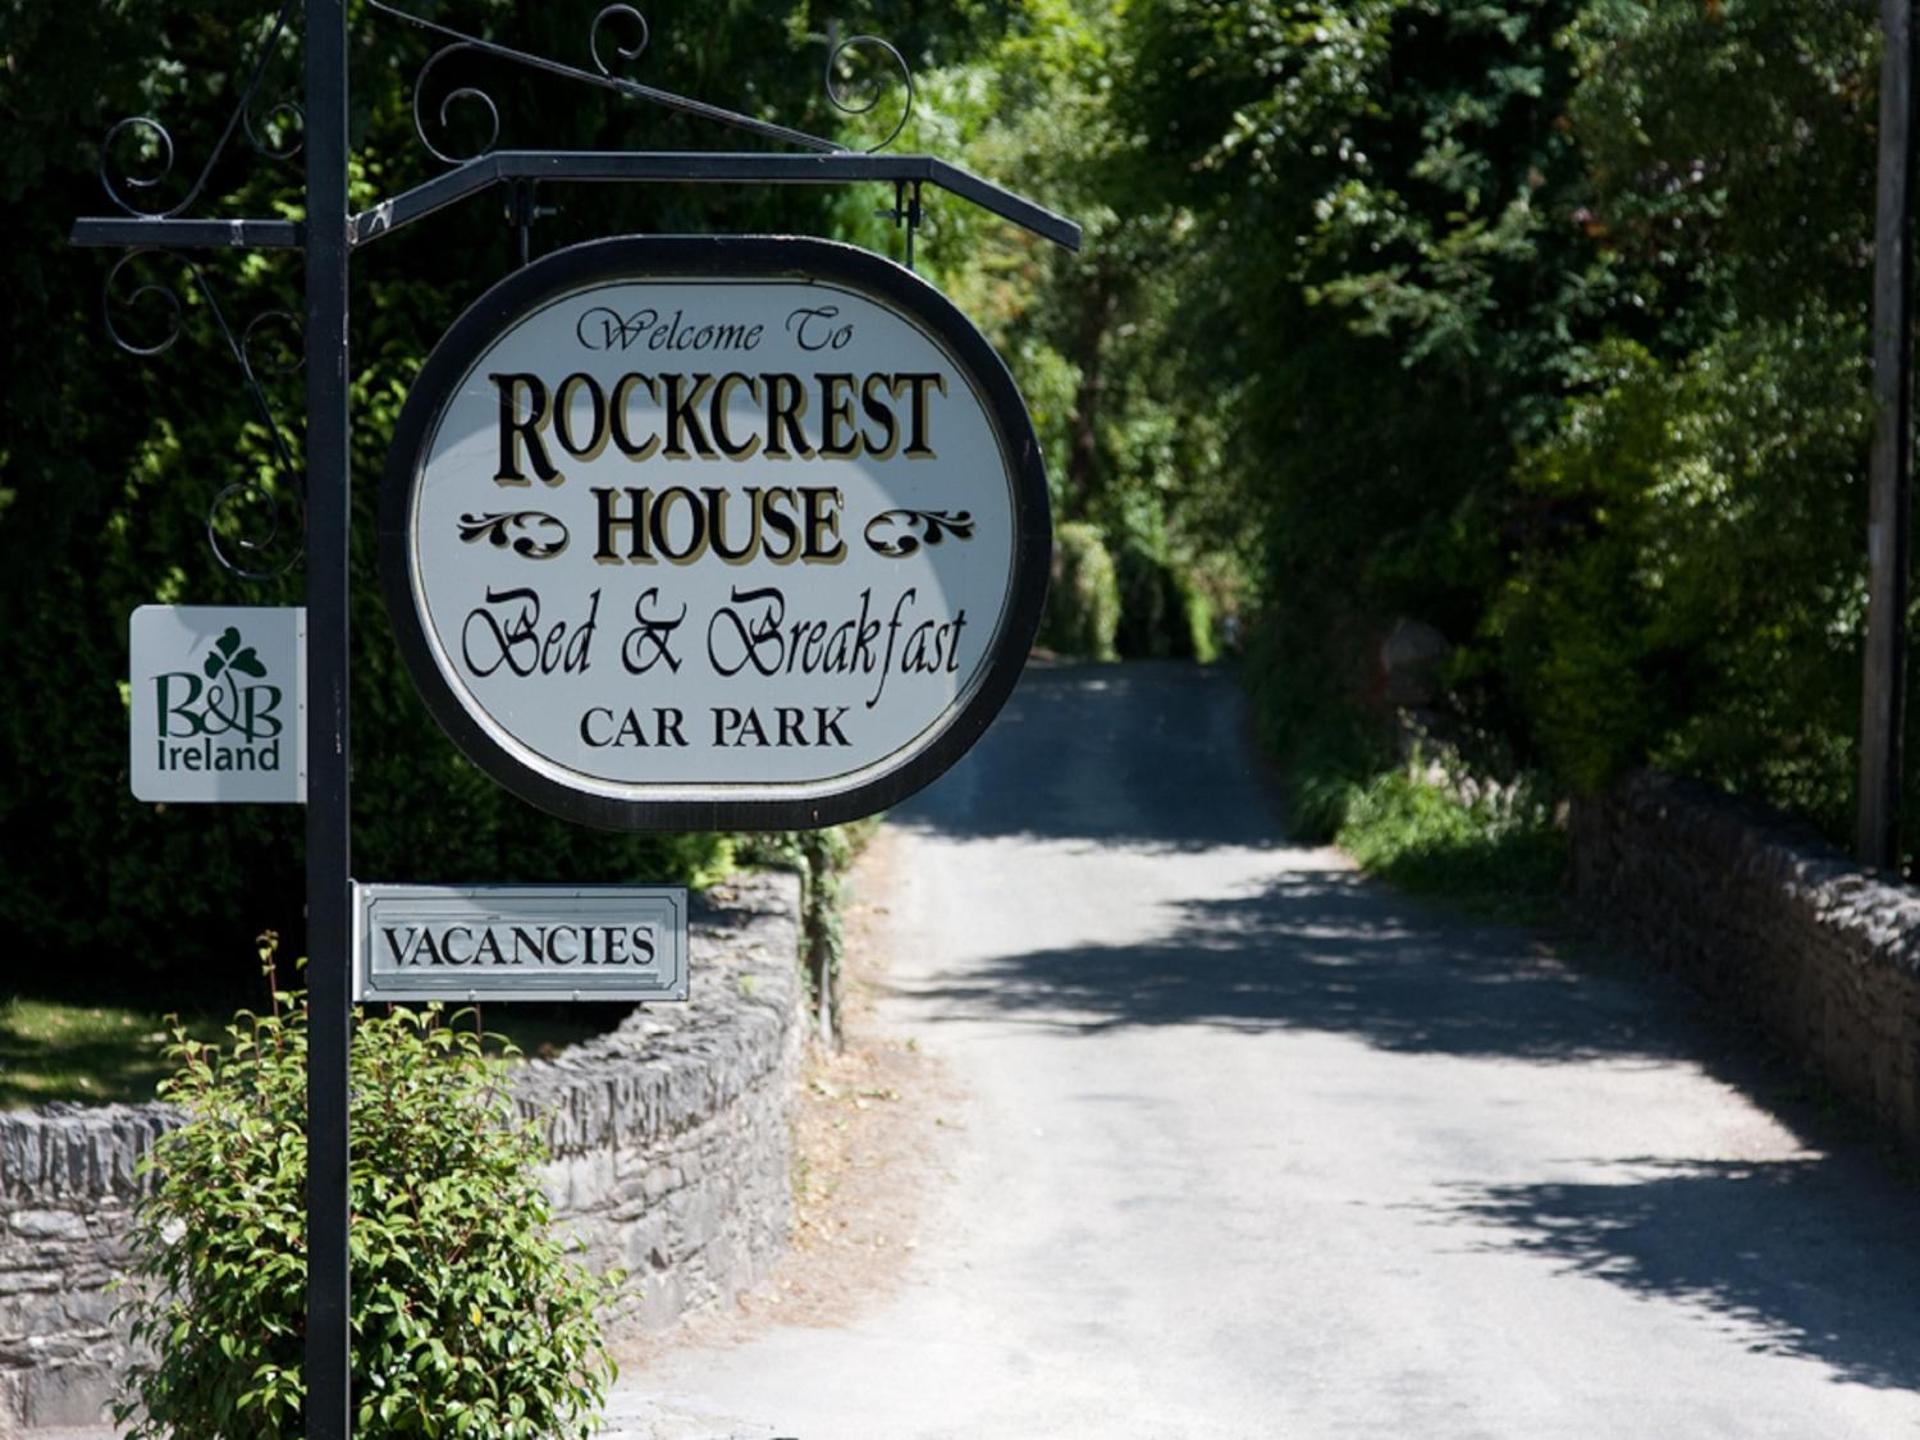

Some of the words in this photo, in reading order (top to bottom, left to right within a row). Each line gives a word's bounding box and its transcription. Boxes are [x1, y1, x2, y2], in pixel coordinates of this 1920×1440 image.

[576, 307, 764, 352] Welcome
[786, 306, 853, 351] To
[488, 371, 947, 486] ROCKCREST
[589, 485, 848, 566] HOUSE
[461, 584, 601, 678] Bed
[621, 587, 688, 676] &
[707, 584, 968, 709] Breakfast
[151, 670, 283, 744] B&B
[579, 706, 690, 748] CAR
[710, 706, 853, 748] PARK
[157, 739, 281, 772] Ireland
[382, 925, 656, 967] VACANCIES
